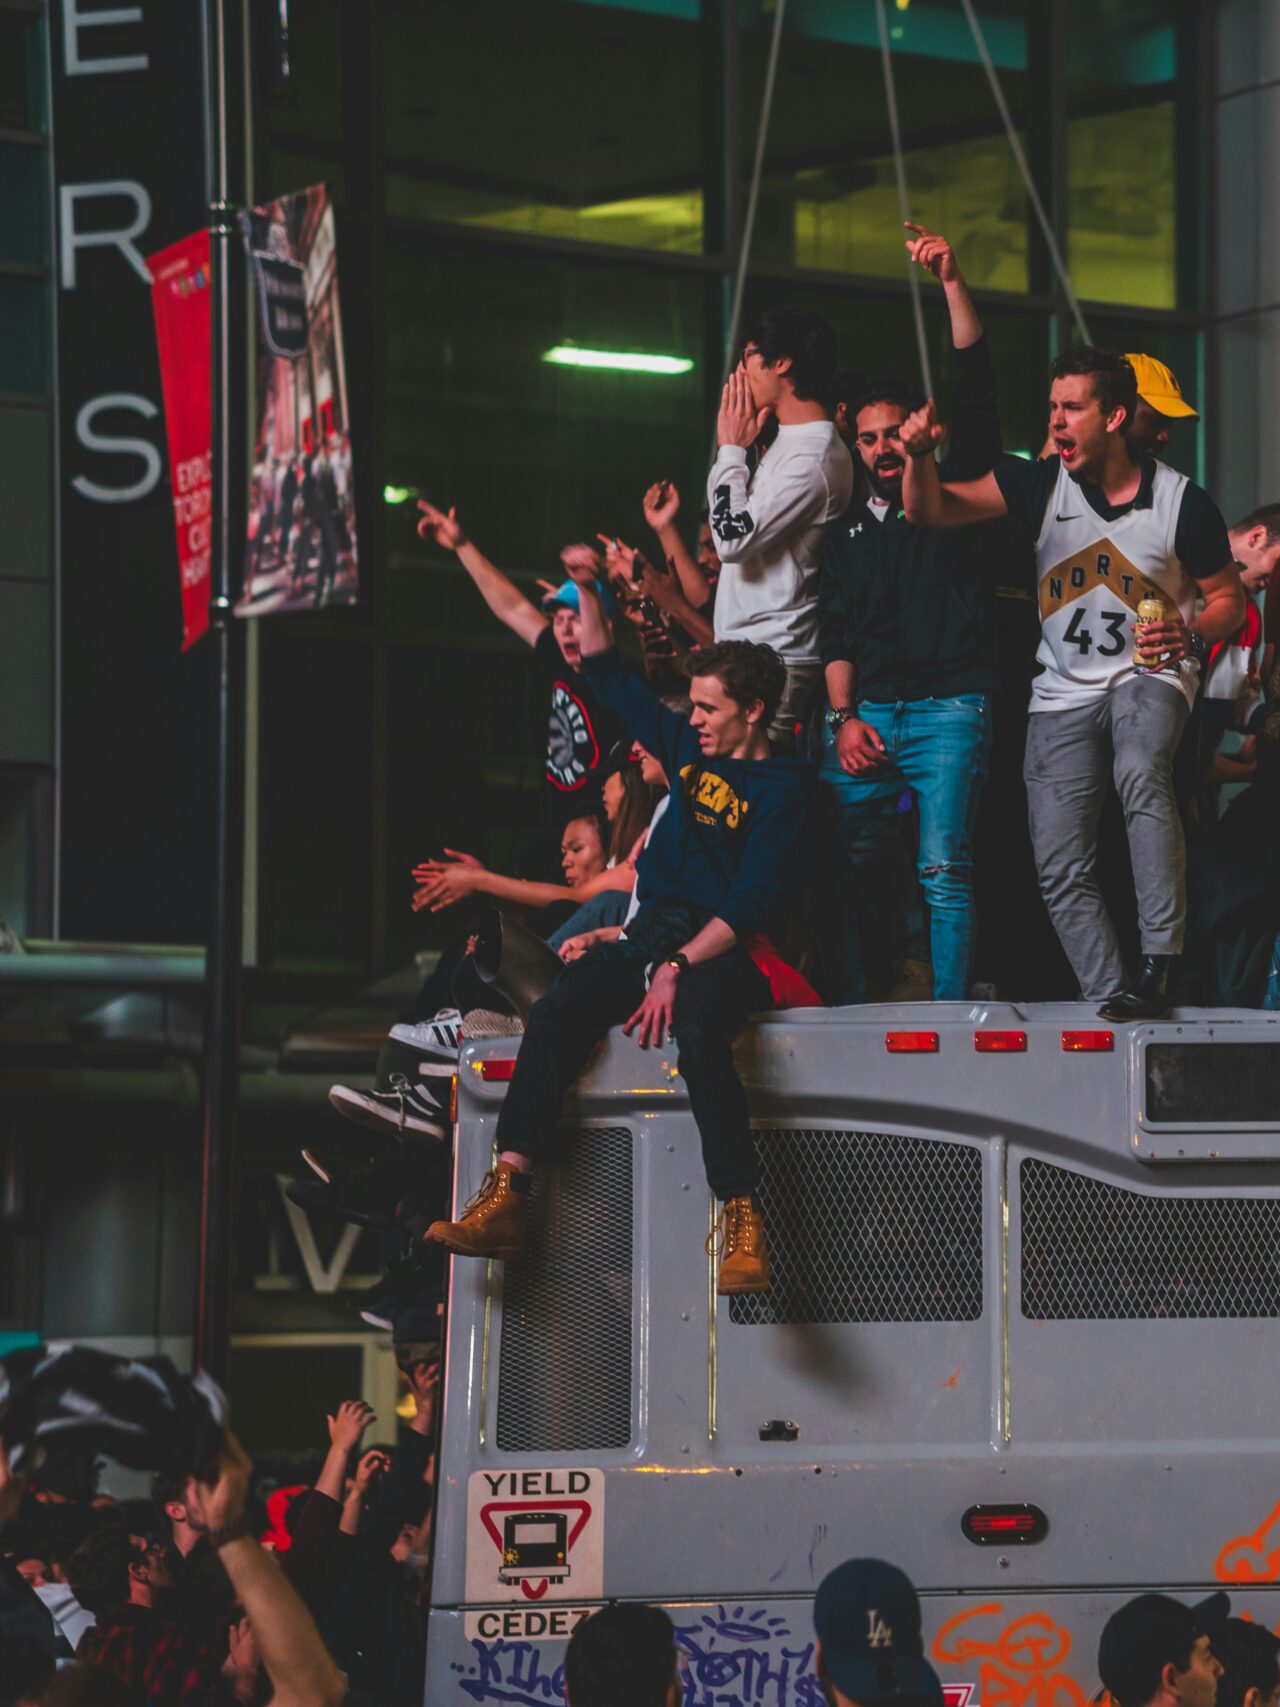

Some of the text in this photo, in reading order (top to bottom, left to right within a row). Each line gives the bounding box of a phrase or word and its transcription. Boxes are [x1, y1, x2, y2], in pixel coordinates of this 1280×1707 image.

[1062, 607, 1127, 658] 43
[483, 1470, 592, 1497] YIELD
[867, 1609, 894, 1649] LA
